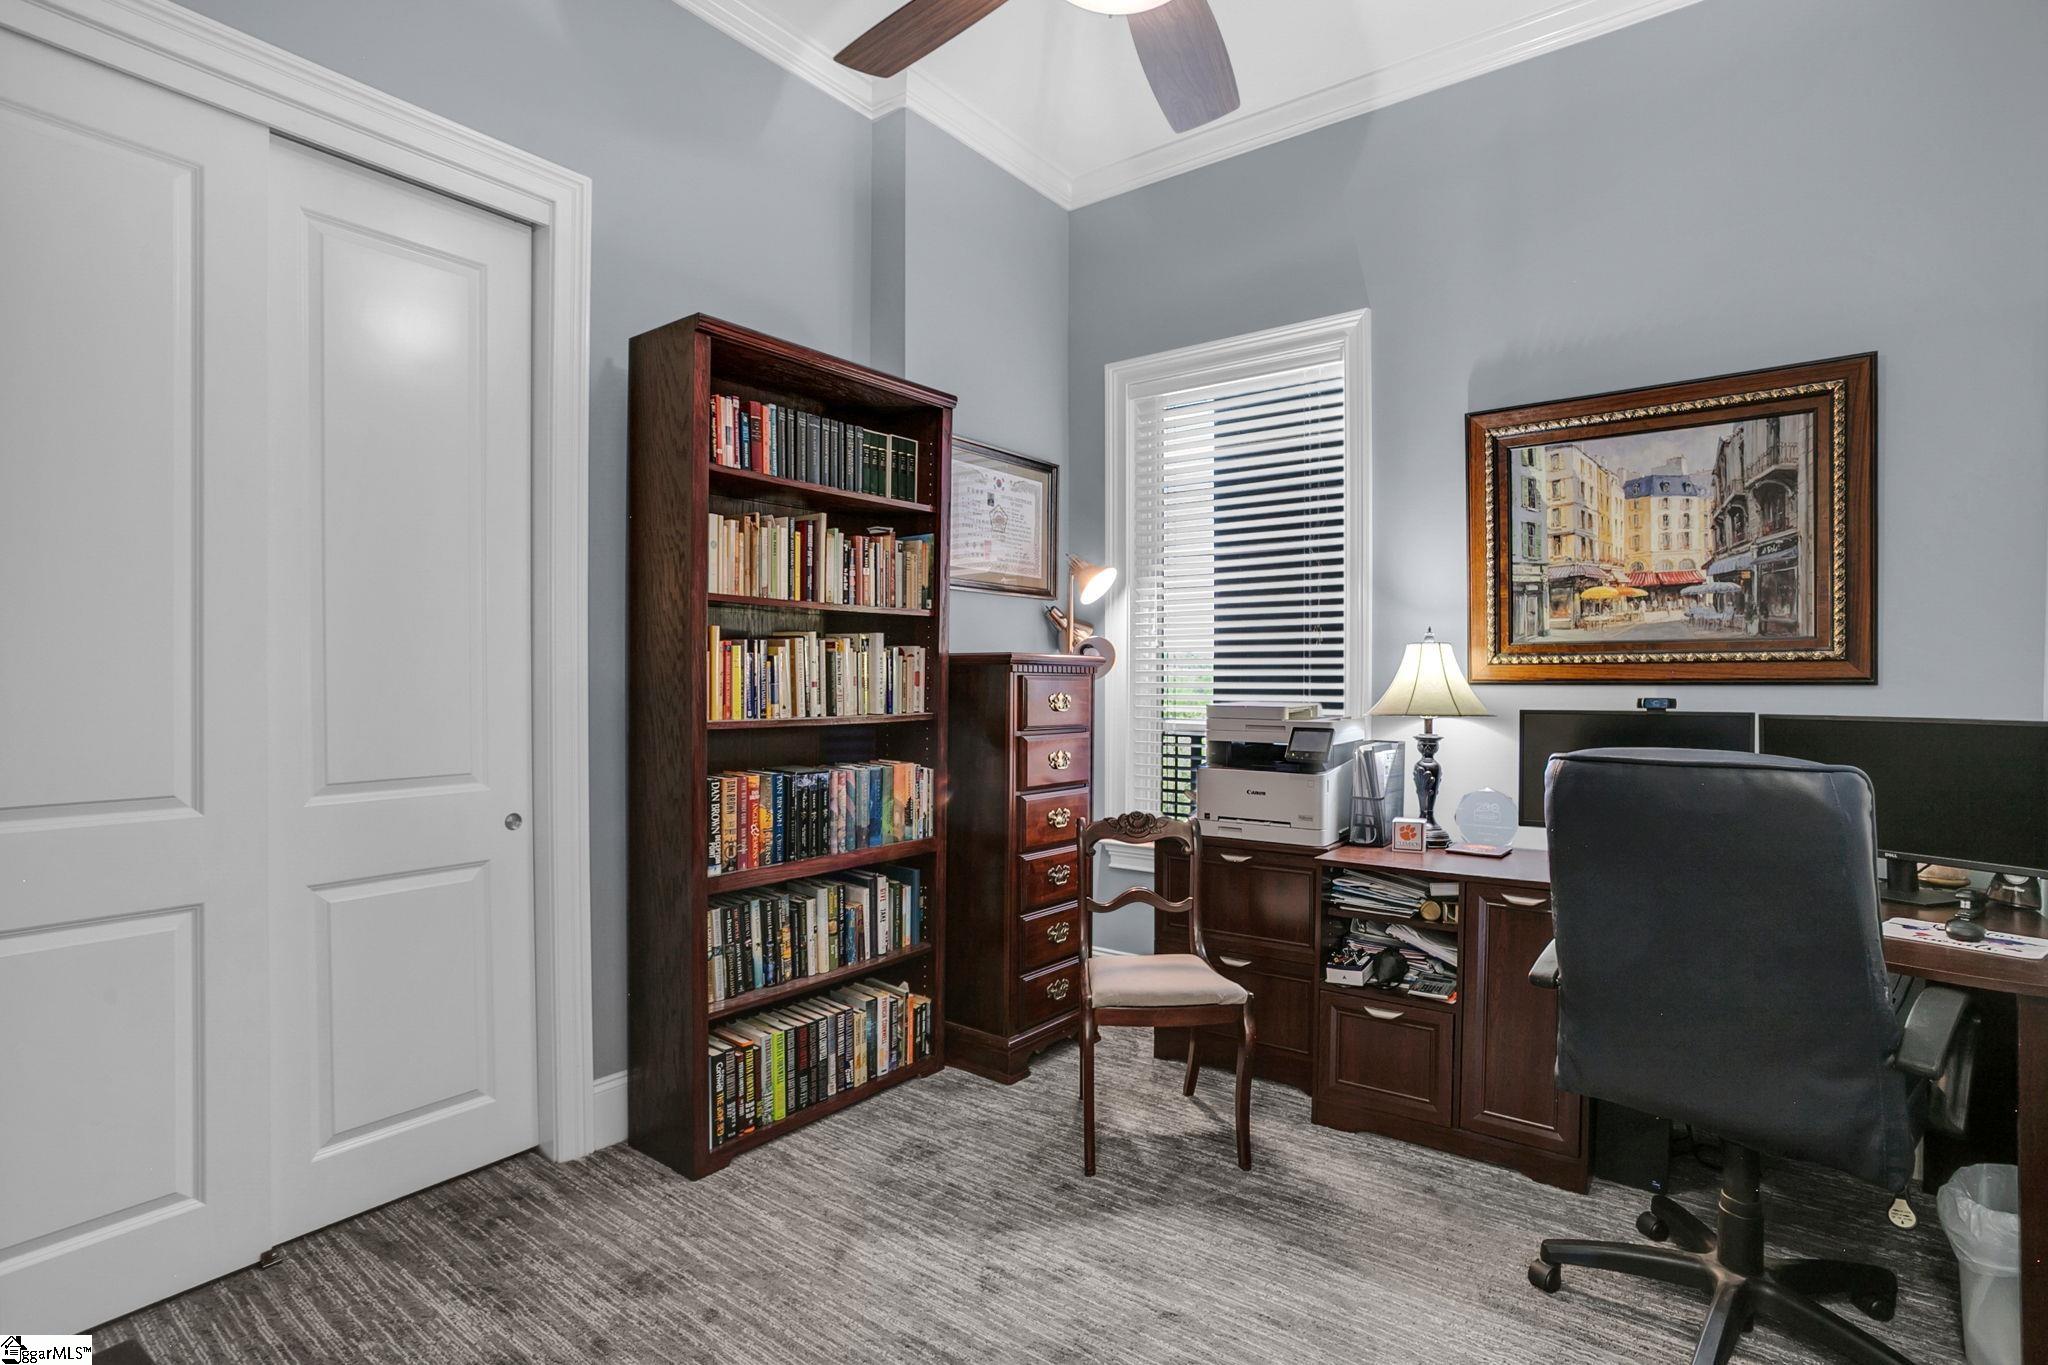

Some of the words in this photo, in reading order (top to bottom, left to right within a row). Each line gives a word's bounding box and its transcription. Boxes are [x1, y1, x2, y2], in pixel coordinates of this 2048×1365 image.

[711, 782, 720, 801] DAN
[727, 781, 735, 792] DAN
[726, 794, 735, 815] BROWN
[711, 804, 720, 834] BROWN
[745, 1049, 754, 1073] PATRICIA
[746, 1073, 755, 1102] CORNWELL
